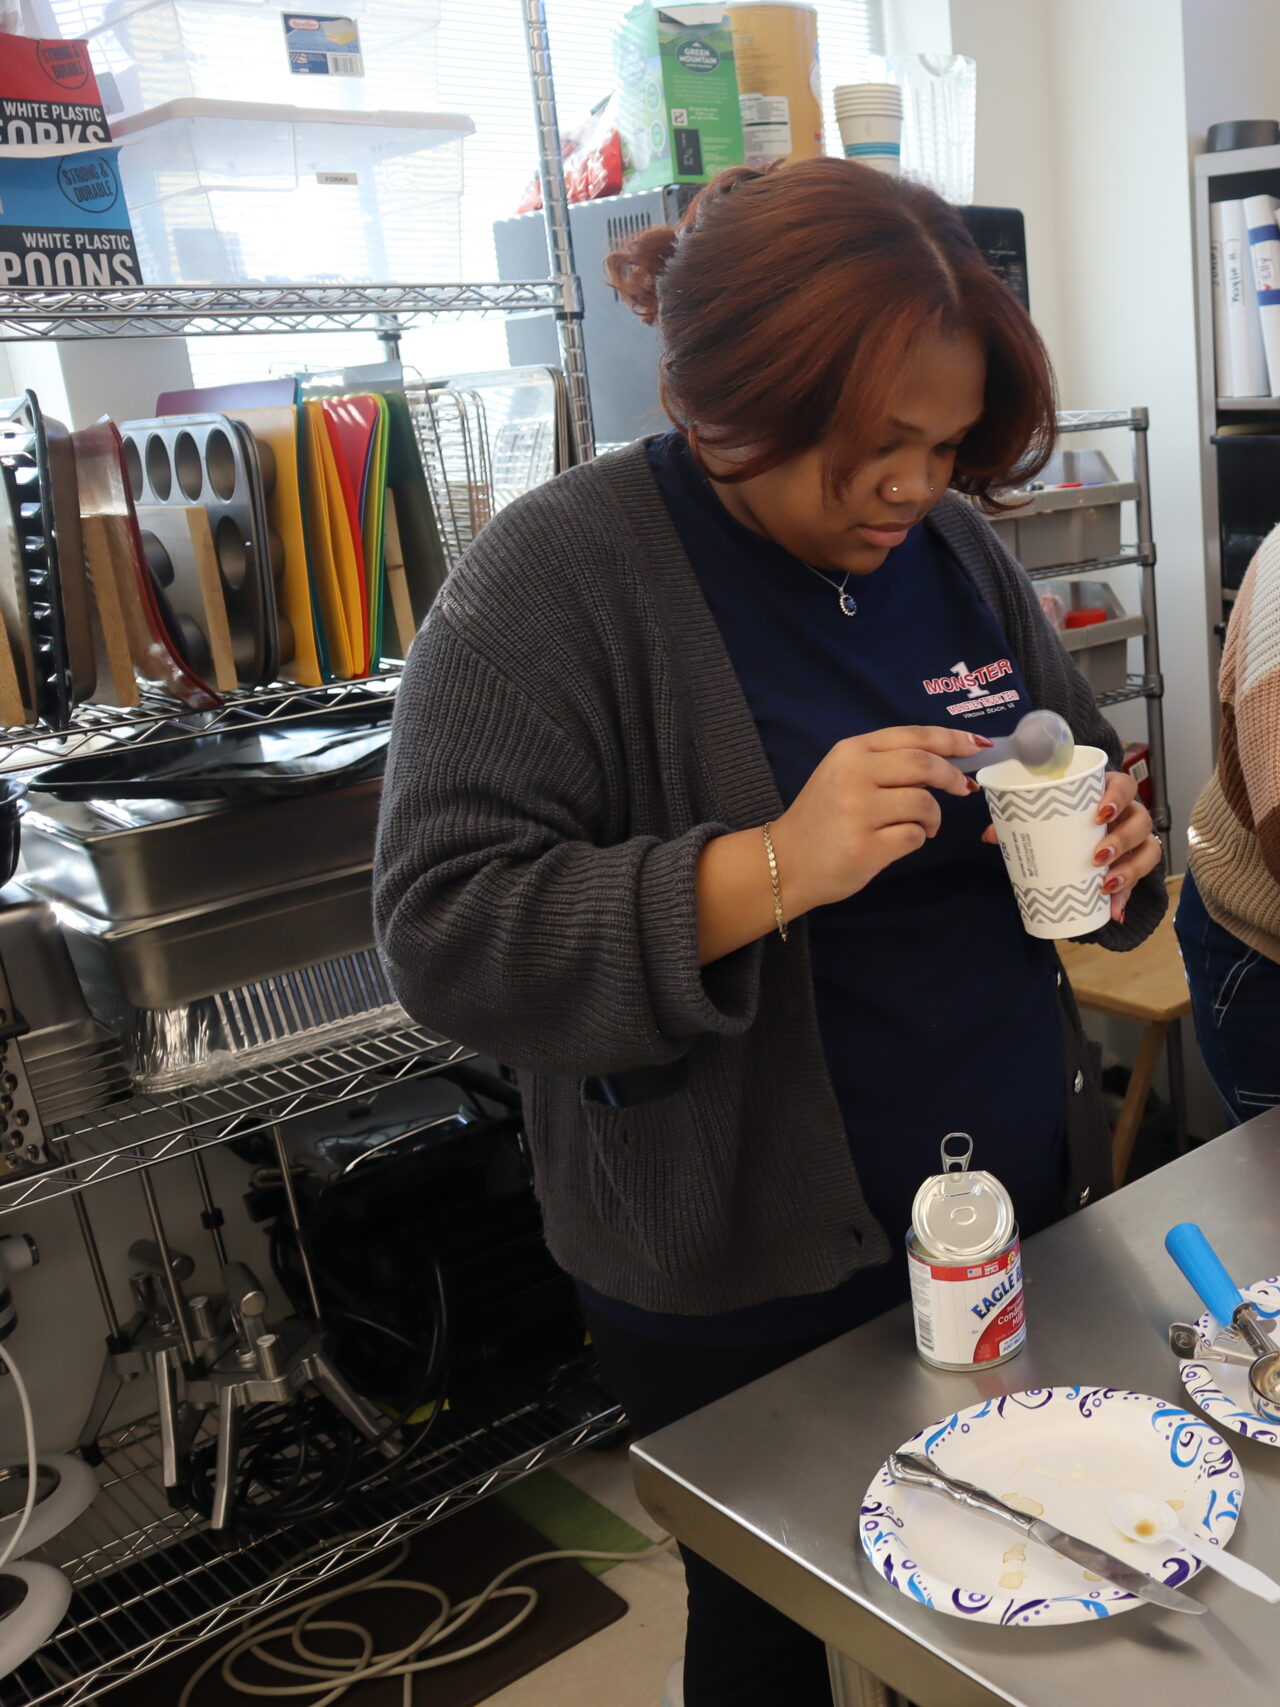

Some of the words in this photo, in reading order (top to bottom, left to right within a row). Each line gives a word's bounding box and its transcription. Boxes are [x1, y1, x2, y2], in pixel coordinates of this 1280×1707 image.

[684, 48, 710, 56] GREEN
[2, 101, 49, 119] WHITE
[51, 105, 102, 122] PLASTIC
[0, 119, 105, 144] ORKS
[62, 163, 100, 186] STRONG
[99, 162, 109, 178] &
[73, 180, 114, 203] DURABLE
[22, 232, 72, 249] WHITE
[75, 234, 131, 250] PLASTIC
[922, 658, 1013, 695] MONSTER
[946, 699, 983, 716] MONSTER
[971, 1272, 1015, 1320] EAGLE
